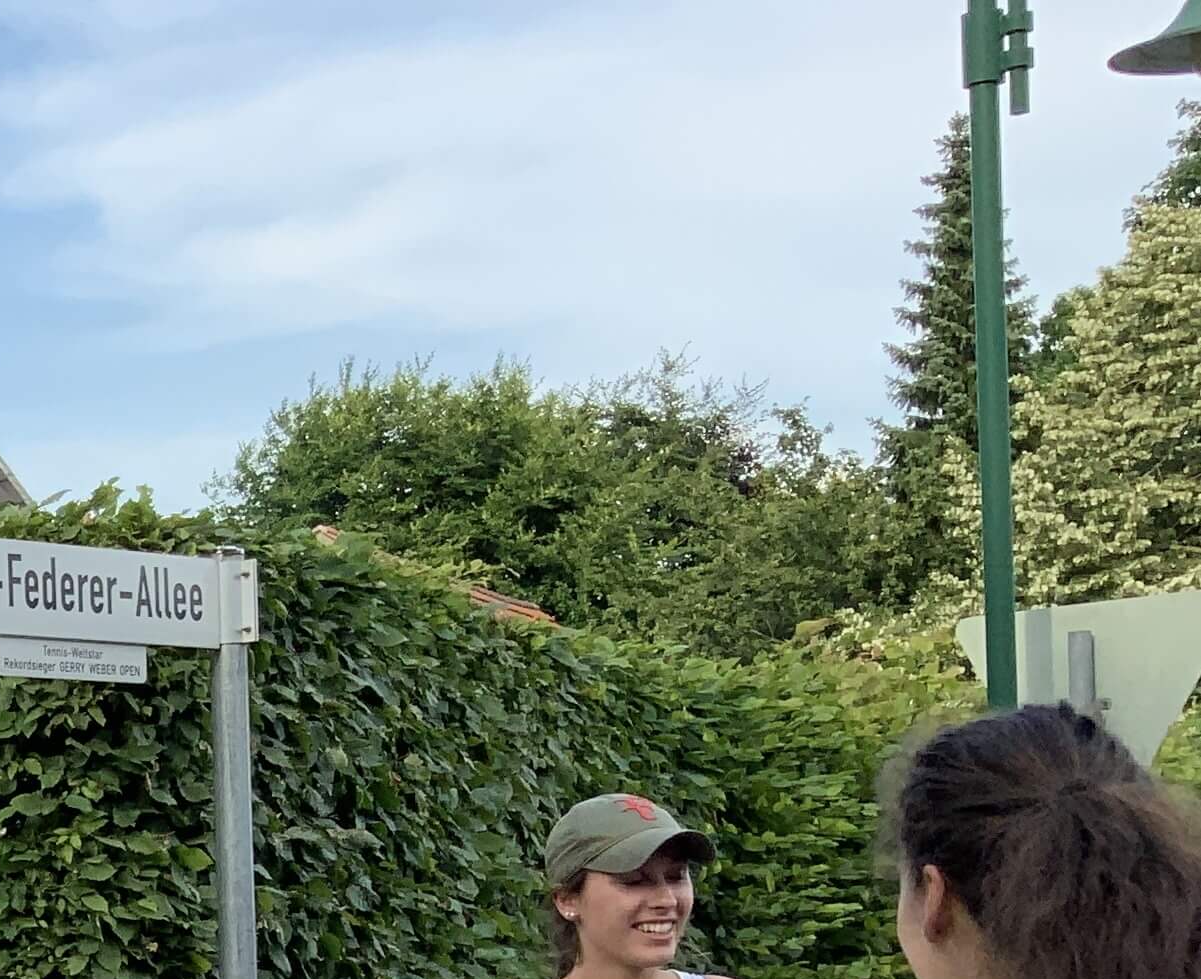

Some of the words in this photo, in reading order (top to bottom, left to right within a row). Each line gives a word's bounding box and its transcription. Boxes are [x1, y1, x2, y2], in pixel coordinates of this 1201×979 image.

[42, 645, 104, 659] Tennis-Weltstar
[3, 657, 56, 674] Rekordsieger
[59, 661, 85, 673] GERRY
[88, 663, 117, 676] WEBER
[119, 664, 141, 677] OPEN
